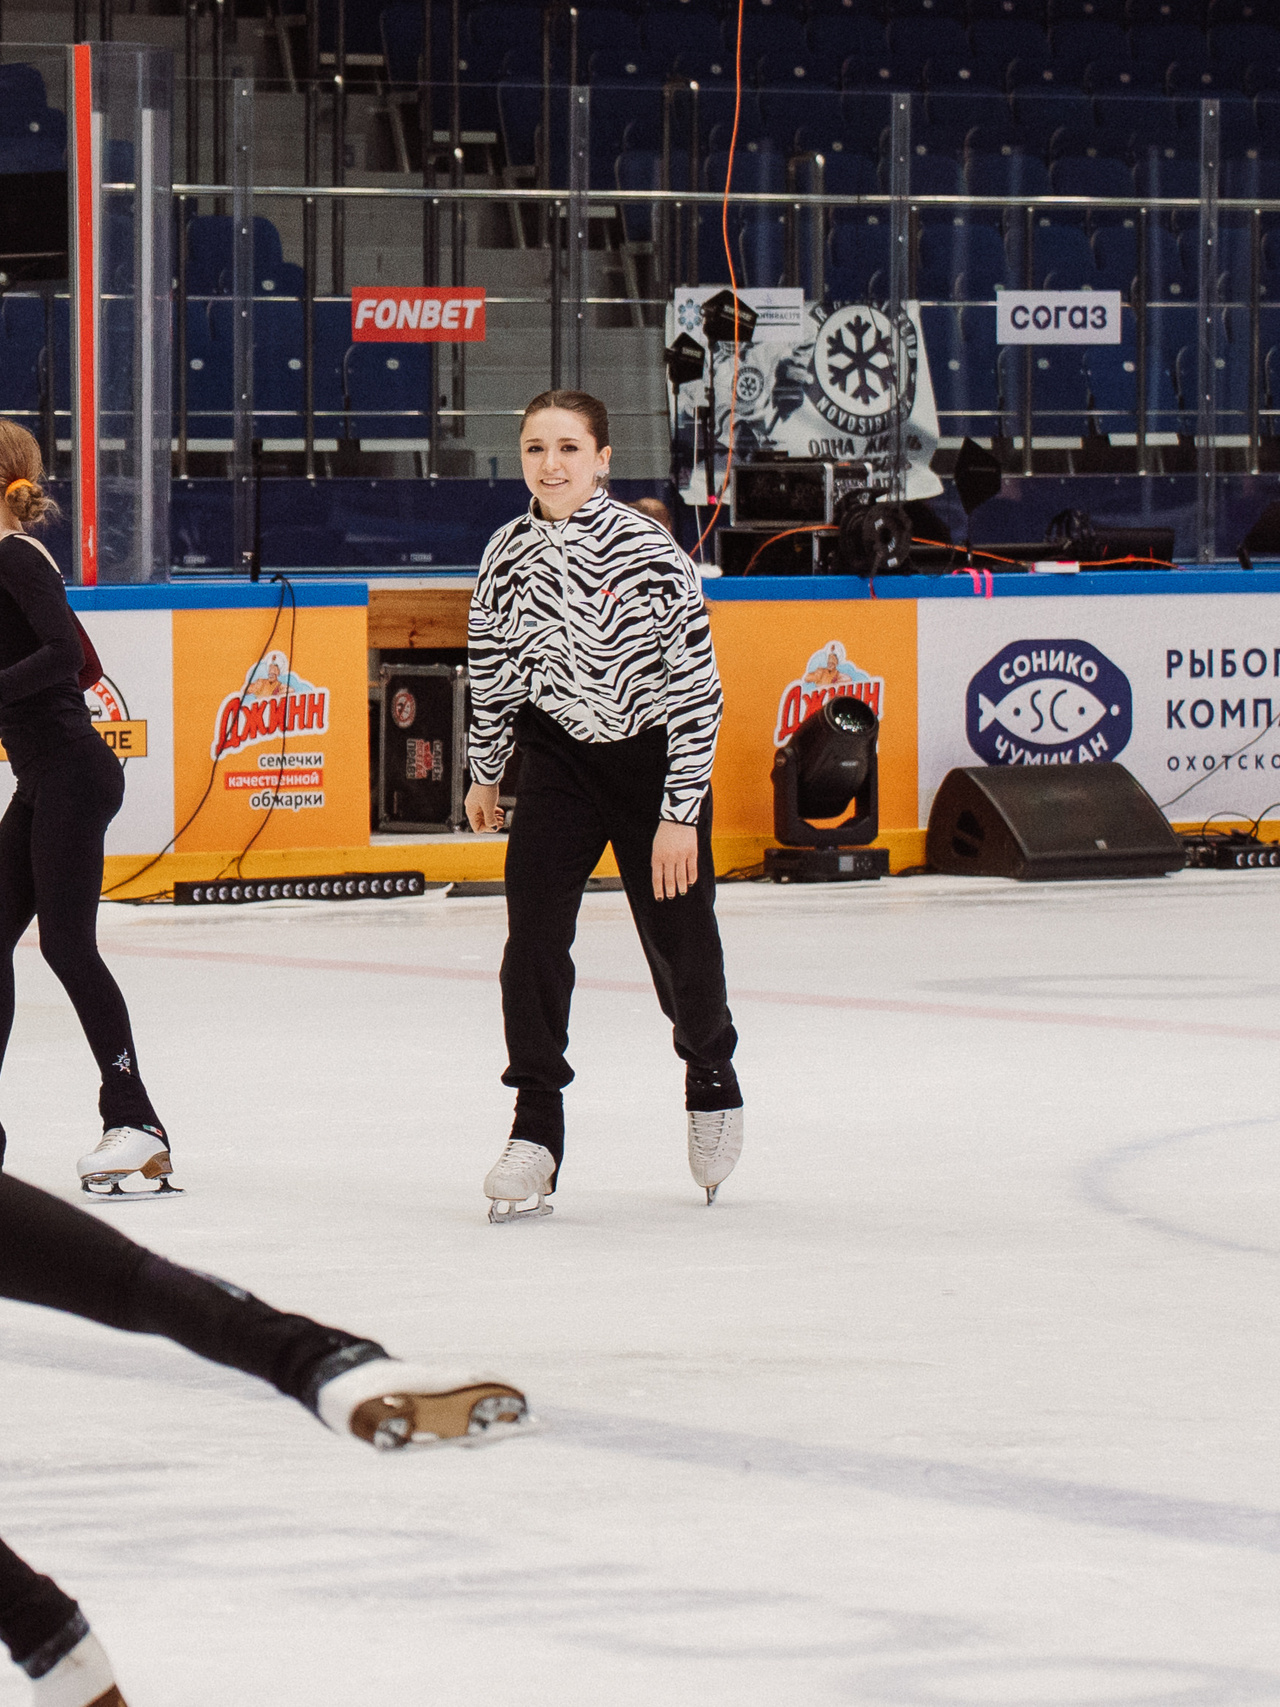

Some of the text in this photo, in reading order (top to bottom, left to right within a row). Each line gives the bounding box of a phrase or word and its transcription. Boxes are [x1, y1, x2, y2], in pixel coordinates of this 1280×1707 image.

[354, 298, 483, 330] FONBET
[999, 649, 1098, 685] СОНИКО
[1166, 698, 1280, 729] КОМП
[259, 754, 322, 767] семечки
[228, 771, 319, 787] качественной
[252, 791, 323, 809] обжарки
